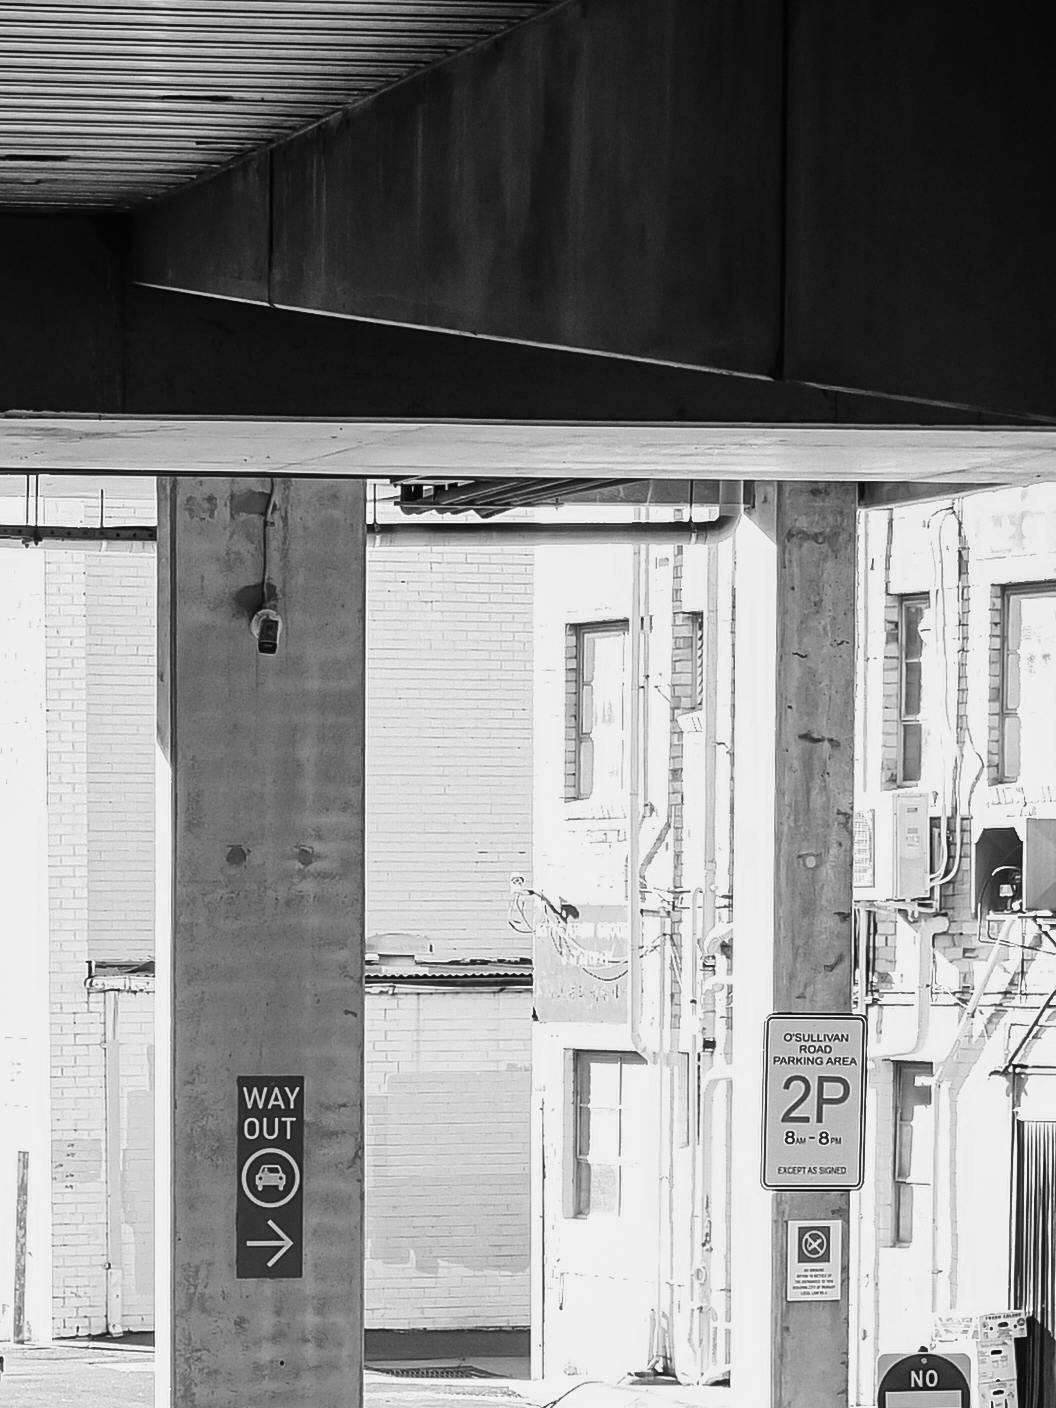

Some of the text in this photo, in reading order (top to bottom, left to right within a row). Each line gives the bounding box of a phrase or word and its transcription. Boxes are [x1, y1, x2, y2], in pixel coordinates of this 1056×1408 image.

[783, 1032, 850, 1043] O'SULLIVAN
[799, 1044, 833, 1054] ROAD
[772, 1056, 858, 1066] PARKING AREA
[242, 1086, 301, 1110] WAY
[780, 1074, 851, 1124] 2P
[243, 1117, 297, 1140] OUT
[777, 1166, 847, 1175] EXCEPT AS SIGNED
[910, 1369, 939, 1388] NO
